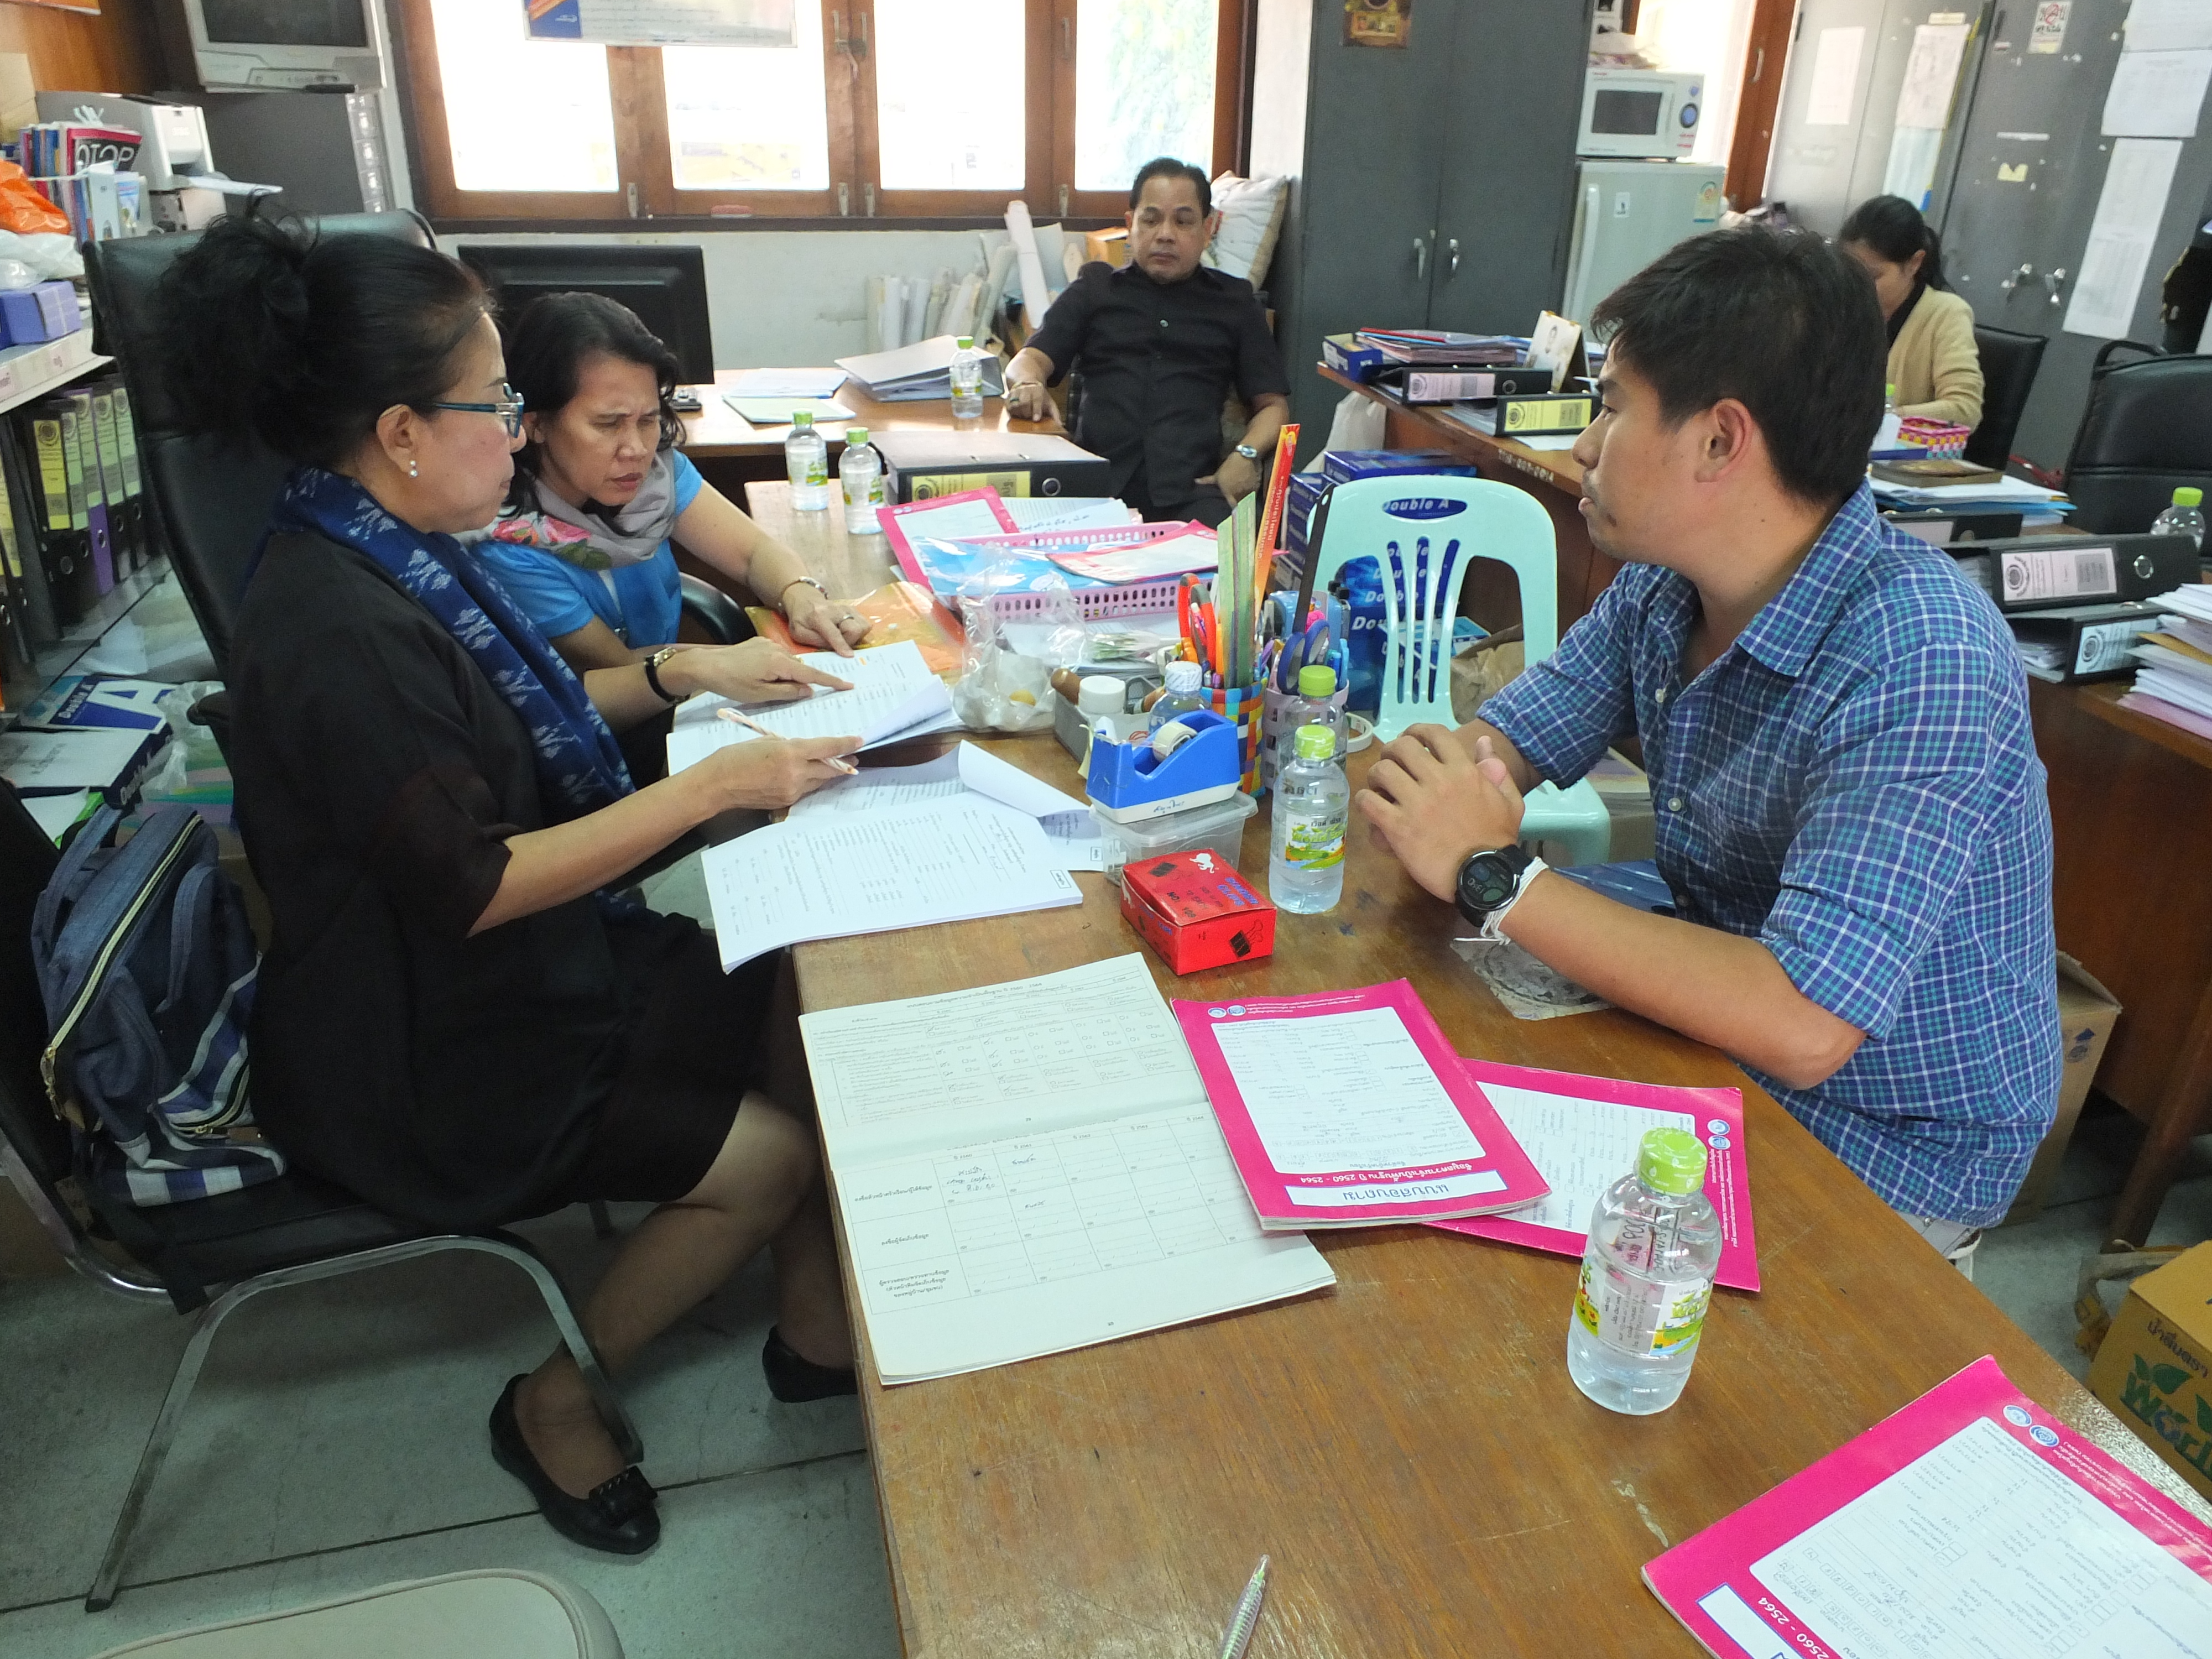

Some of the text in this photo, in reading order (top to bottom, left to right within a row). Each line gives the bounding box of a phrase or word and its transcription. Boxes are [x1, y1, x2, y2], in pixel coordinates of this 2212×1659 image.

[1332, 1173, 1356, 1182] 2560
[1342, 1183, 1450, 1201] แบบสอบถาม
[1756, 1595, 1791, 1627] 2564
[1794, 1630, 1830, 1659] 2560
